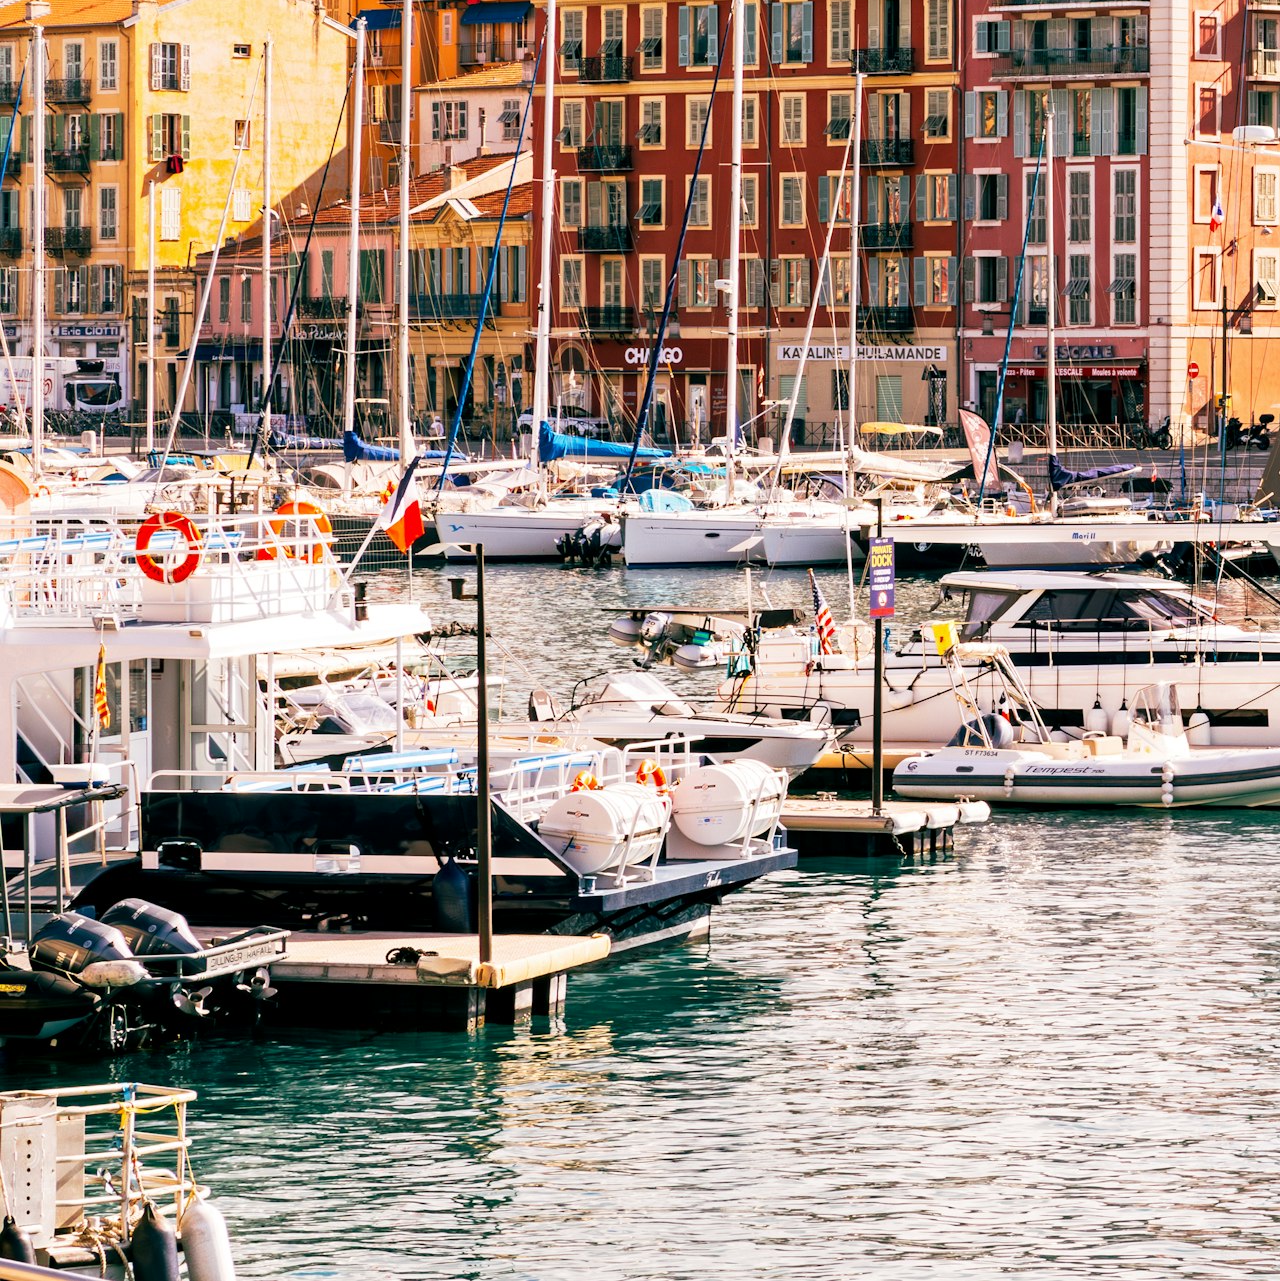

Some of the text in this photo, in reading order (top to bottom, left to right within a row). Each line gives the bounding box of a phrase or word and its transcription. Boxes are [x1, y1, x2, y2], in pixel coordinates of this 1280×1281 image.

[61, 327, 81, 335] Eric
[1055, 368, 1083, 376] L'ESCALE
[1092, 368, 1111, 376] Moules
[871, 545, 893, 555] PRIVATE
[871, 554, 893, 568] DOCK
[1025, 765, 1093, 775] Tempest
